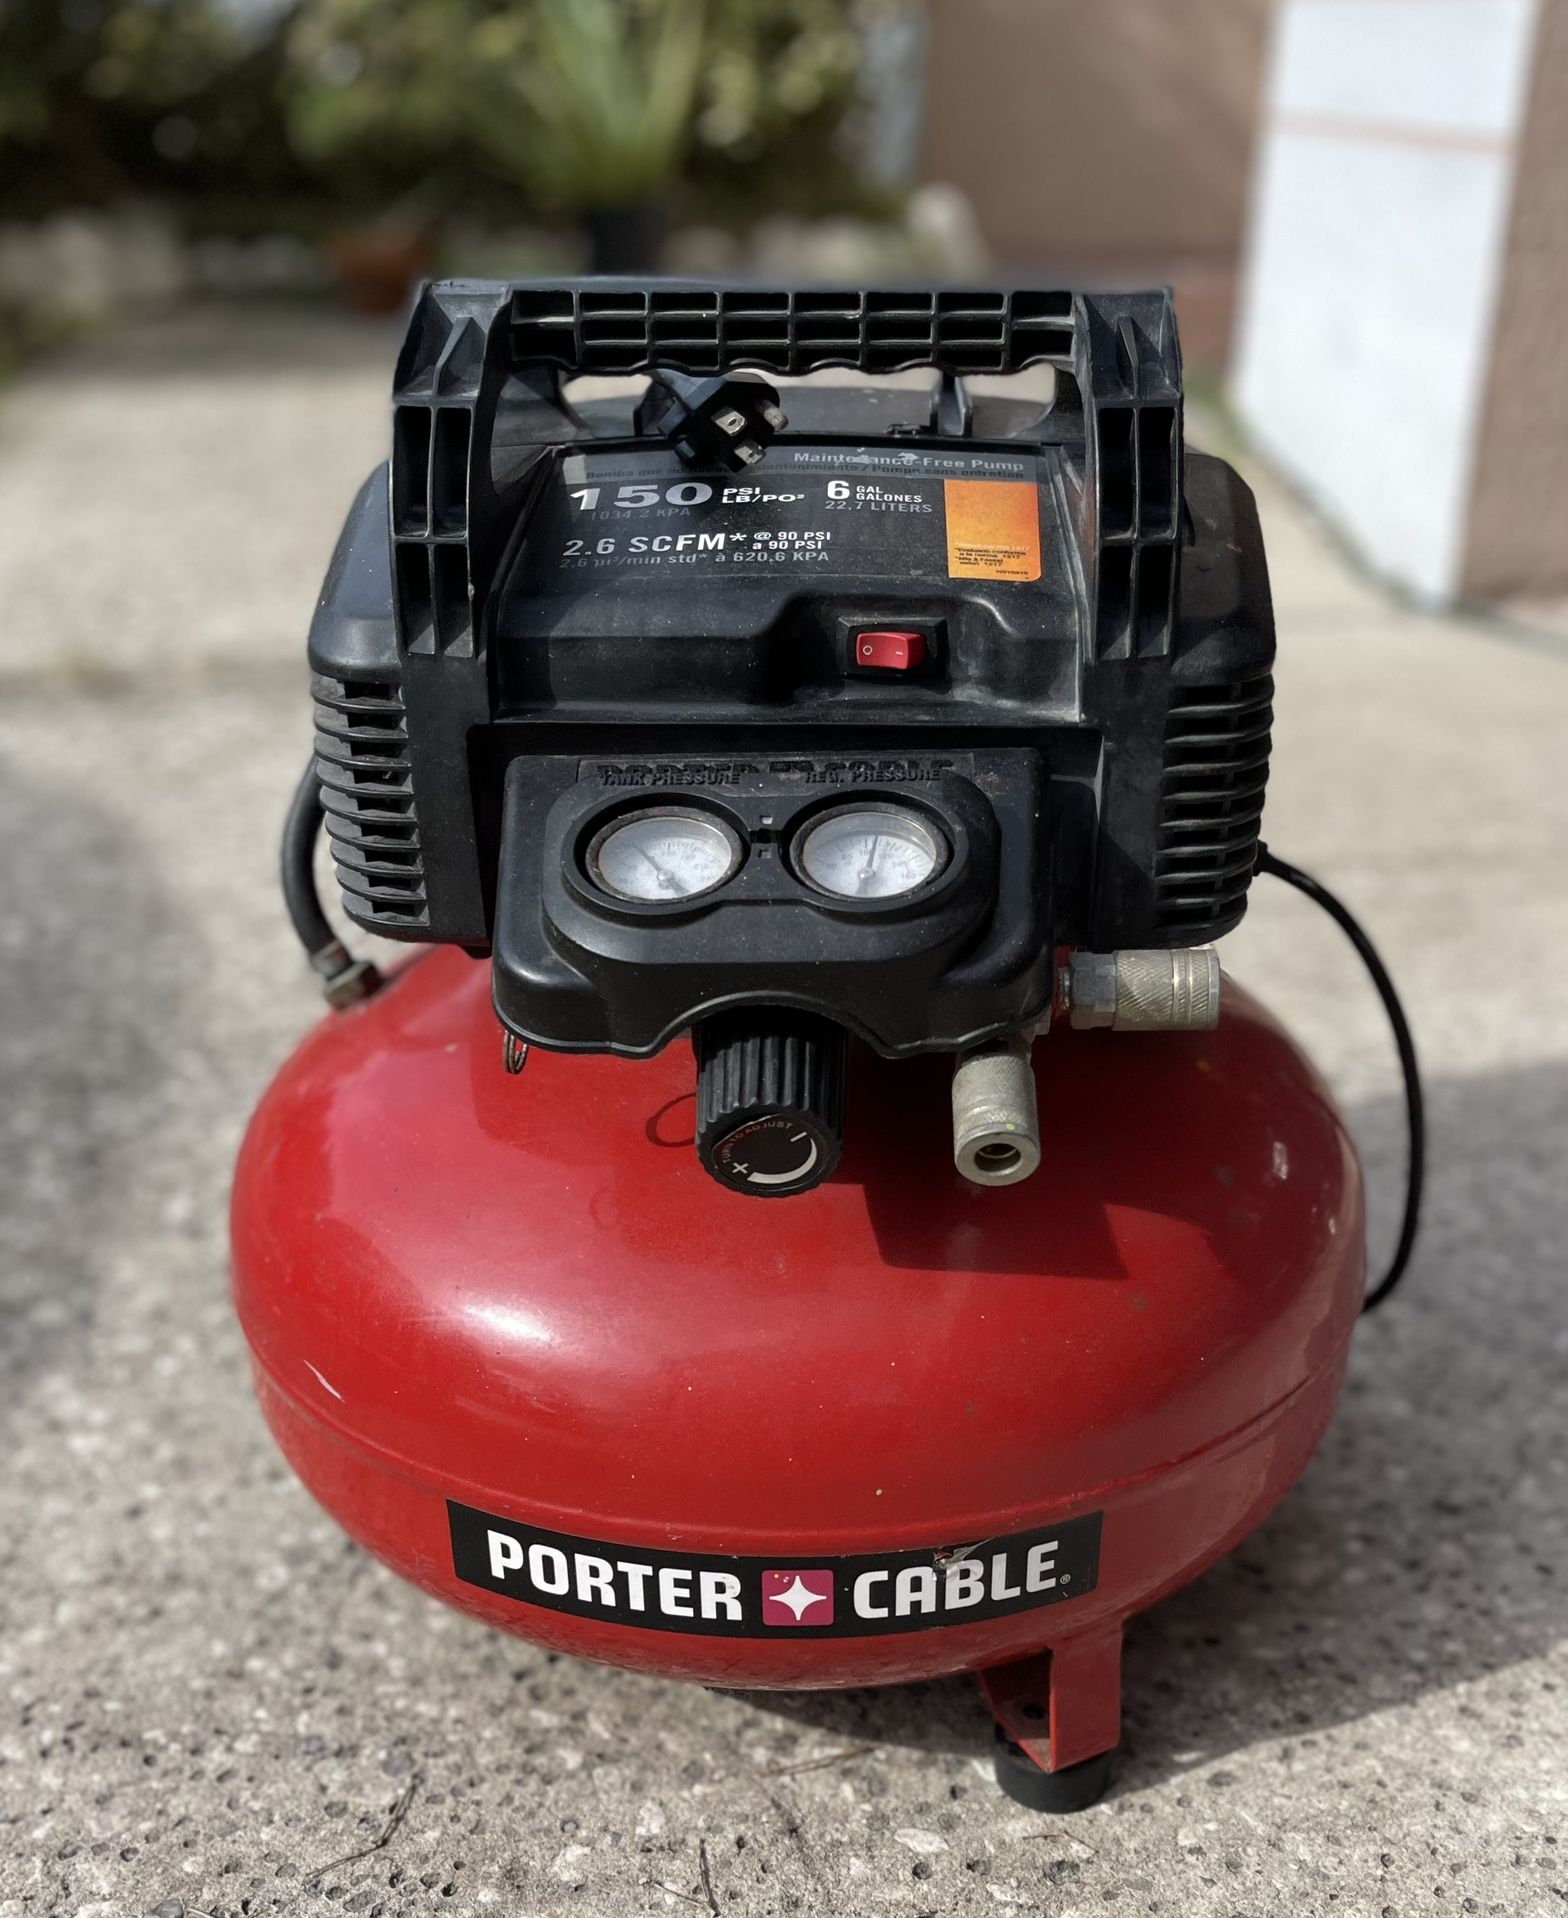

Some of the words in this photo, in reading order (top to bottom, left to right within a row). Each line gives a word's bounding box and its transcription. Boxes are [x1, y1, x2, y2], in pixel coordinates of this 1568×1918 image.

[794, 452, 965, 469] Mainteance-Free
[971, 459, 1024, 472] Pump
[570, 482, 713, 511] 150
[723, 486, 761, 496] PSI
[827, 480, 850, 500] 6
[856, 485, 884, 494] GAL
[856, 493, 923, 503] GALONES
[591, 509, 650, 520] 1034.2
[656, 507, 691, 517] KPA
[825, 501, 864, 511] 22.7
[870, 502, 933, 513] LITERS
[753, 531, 772, 541] @
[777, 531, 798, 541] 90
[804, 531, 831, 541] PSI
[562, 538, 616, 556] 2.6
[768, 540, 789, 550] 90
[794, 540, 822, 550] PSI
[560, 558, 588, 568] 2.6
[733, 551, 786, 562] 620.6
[793, 551, 830, 562] KPA
[600, 772, 646, 786] TANK
[650, 771, 741, 786] PRESSURE
[851, 769, 942, 783] PRESSURE
[744, 1120, 793, 1134] ADJUST
[486, 1528, 743, 1622] PORTER
